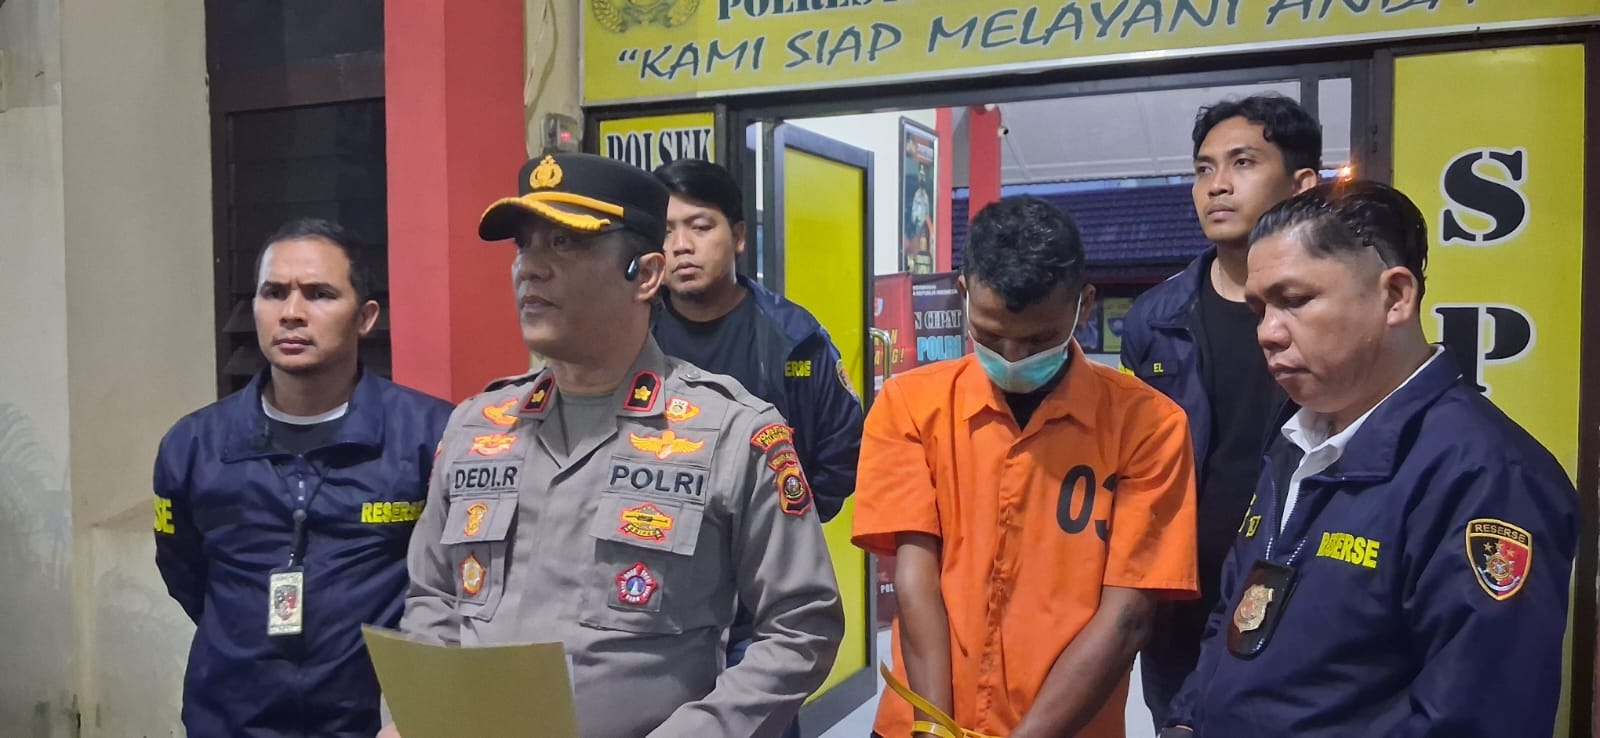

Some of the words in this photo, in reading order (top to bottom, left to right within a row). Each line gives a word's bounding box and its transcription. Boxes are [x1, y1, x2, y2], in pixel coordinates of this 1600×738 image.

[785, 23, 902, 68] SIAP
[927, 0, 1241, 52] MELAYANI
[454, 465, 518, 489] DEDI.R
[610, 464, 704, 497] POLRI
[1474, 524, 1526, 543] RESERSE
